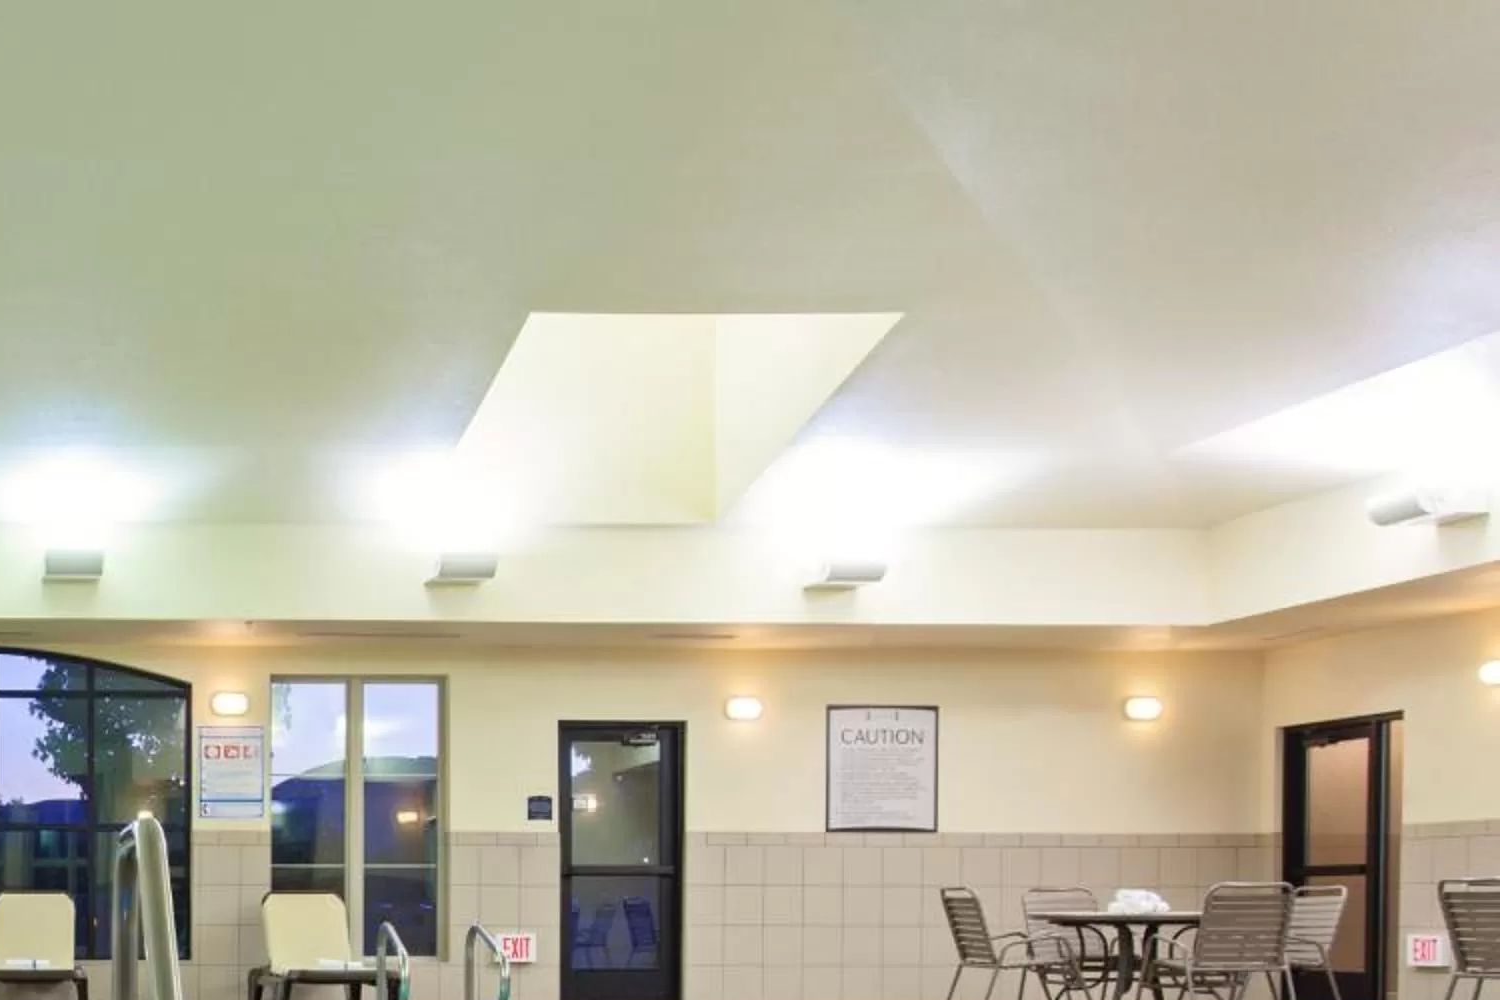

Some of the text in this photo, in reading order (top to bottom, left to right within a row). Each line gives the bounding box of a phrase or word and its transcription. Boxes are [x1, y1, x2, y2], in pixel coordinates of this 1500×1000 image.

[841, 728, 925, 745] CAUTION
[503, 937, 532, 960] EXIT
[1412, 937, 1437, 962] EXIT
